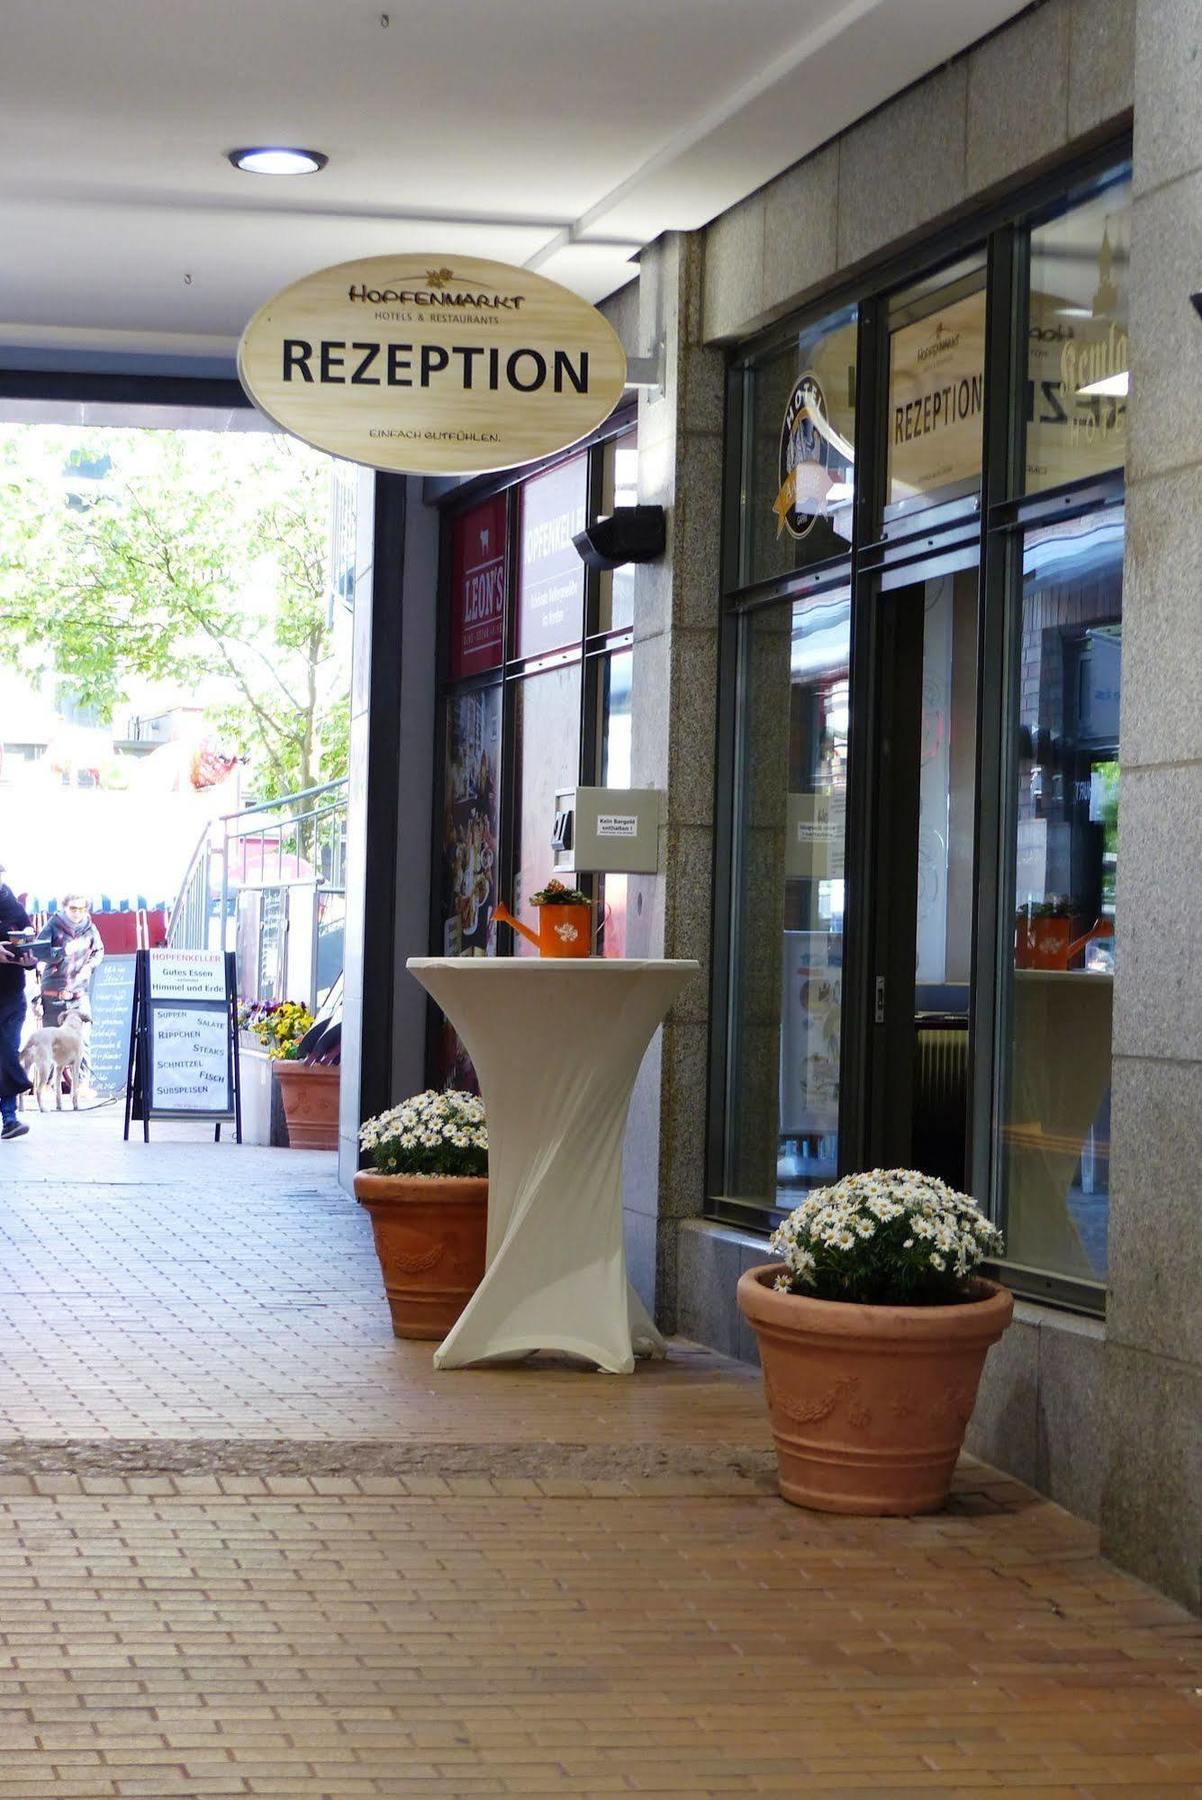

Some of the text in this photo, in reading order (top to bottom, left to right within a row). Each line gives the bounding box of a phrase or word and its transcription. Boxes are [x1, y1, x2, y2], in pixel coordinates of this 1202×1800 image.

[348, 285, 525, 309] HOPFENMARKT
[374, 311, 499, 325] HOTELS & RESTAURANTS
[283, 339, 589, 394] REZEPTION
[894, 372, 983, 446] REZEPTION
[369, 429, 421, 439] EINFACH
[464, 566, 503, 623] LEON'S
[162, 968, 213, 977] Gutes Essen
[152, 983, 185, 992] Himmel
[205, 985, 224, 993] Erde
[158, 1031, 201, 1039] RIPPCHEN
[193, 1044, 225, 1056] STEAKS
[157, 1060, 203, 1069] SCHNITZEL
[200, 1071, 225, 1083] FISCH
